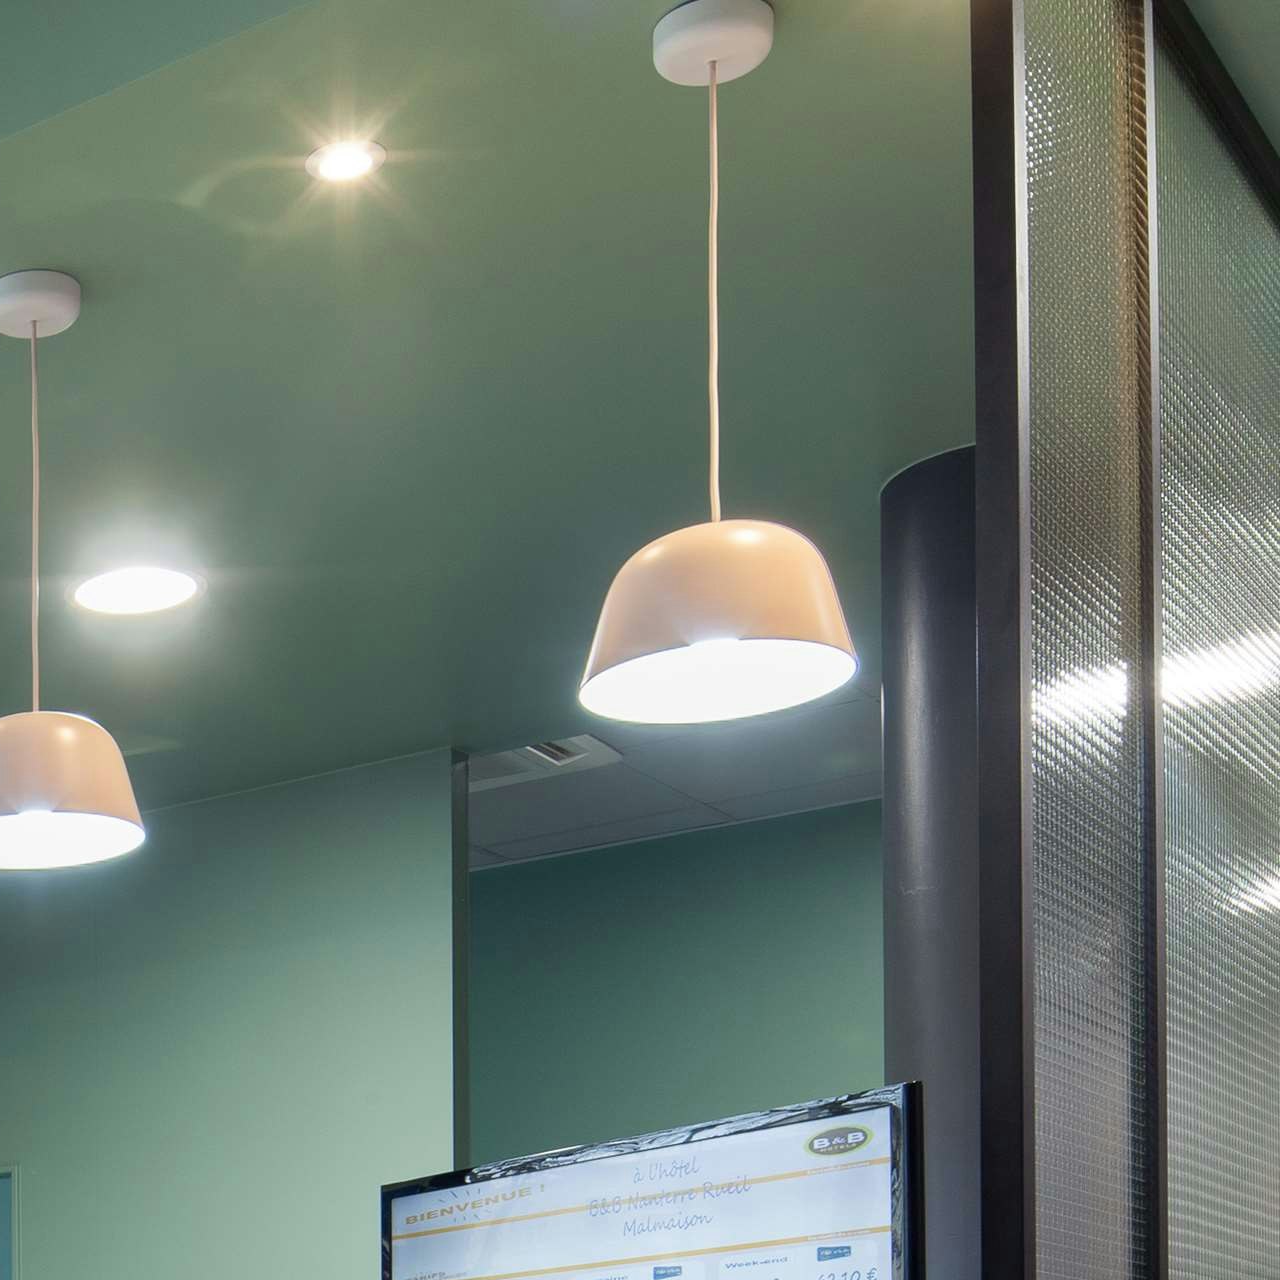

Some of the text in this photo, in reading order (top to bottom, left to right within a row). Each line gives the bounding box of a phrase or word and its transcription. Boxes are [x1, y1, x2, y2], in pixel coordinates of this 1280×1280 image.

[813, 1132, 865, 1149] B&B
[405, 1186, 532, 1225] BIENVENUE
[589, 1175, 752, 1217] B&B Nanterre Rueil
[624, 1211, 714, 1237] Malmaison
